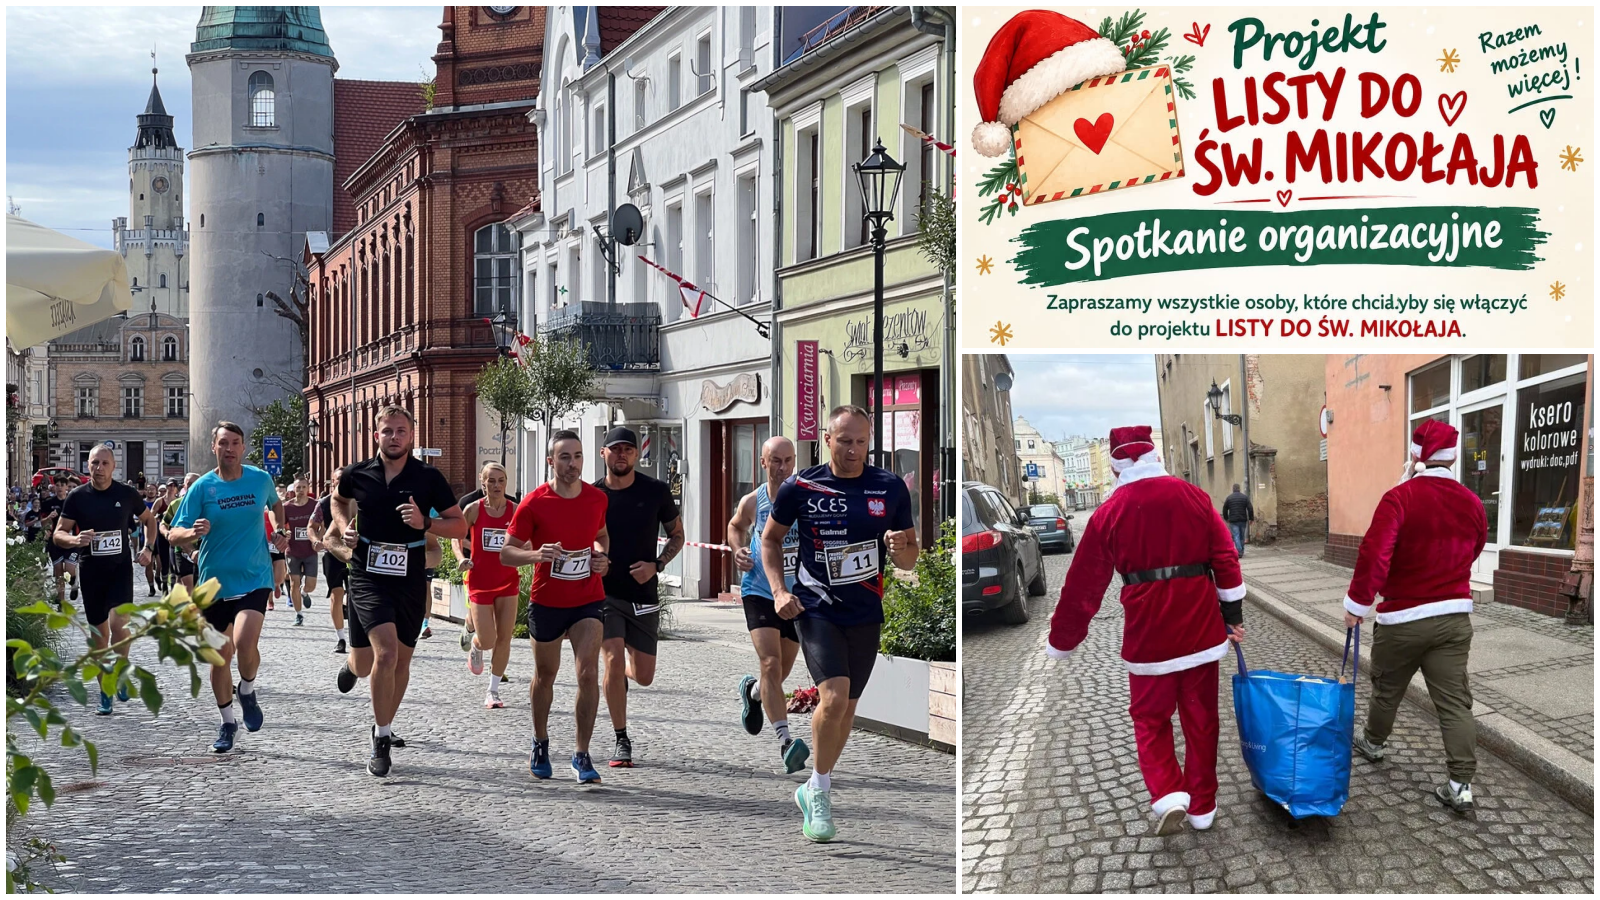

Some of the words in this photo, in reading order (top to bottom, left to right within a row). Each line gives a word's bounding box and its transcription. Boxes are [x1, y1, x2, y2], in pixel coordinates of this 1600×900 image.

[1228, 12, 1387, 70] Projekt
[1478, 24, 1542, 54] Razem
[1490, 42, 1568, 75] możemy
[1213, 67, 1346, 134] LISTY
[1359, 72, 1422, 121] DO
[1192, 128, 1275, 196] ŚW.
[1285, 131, 1539, 190] MIKOŁAJA
[1064, 218, 1247, 277] Spotkanie
[1258, 213, 1503, 264] organizacyjne
[1046, 294, 1152, 314] Zapraszamy
[1157, 293, 1240, 314] wszystkie
[1245, 293, 1299, 314] osoby,
[1303, 293, 1348, 310] które
[1433, 293, 1456, 314] się
[1459, 293, 1528, 314] włączyć
[1109, 319, 1133, 337] do
[1138, 319, 1210, 341] projektu
[1216, 318, 1274, 337] LISTY
[1280, 318, 1312, 337] DO
[1317, 315, 1354, 338] ŚW.
[1360, 319, 1467, 338] MIKOŁAJA.
[800, 344, 816, 436] Kwiaciarnia
[1530, 401, 1572, 429] ksero
[479, 446, 502, 455] Poczt
[1523, 429, 1577, 452] kolorowe
[1521, 455, 1549, 471] wydruki:
[102, 537, 121, 549] 142
[381, 552, 406, 567] 102
[572, 558, 587, 572] 77
[852, 553, 873, 571] 11
